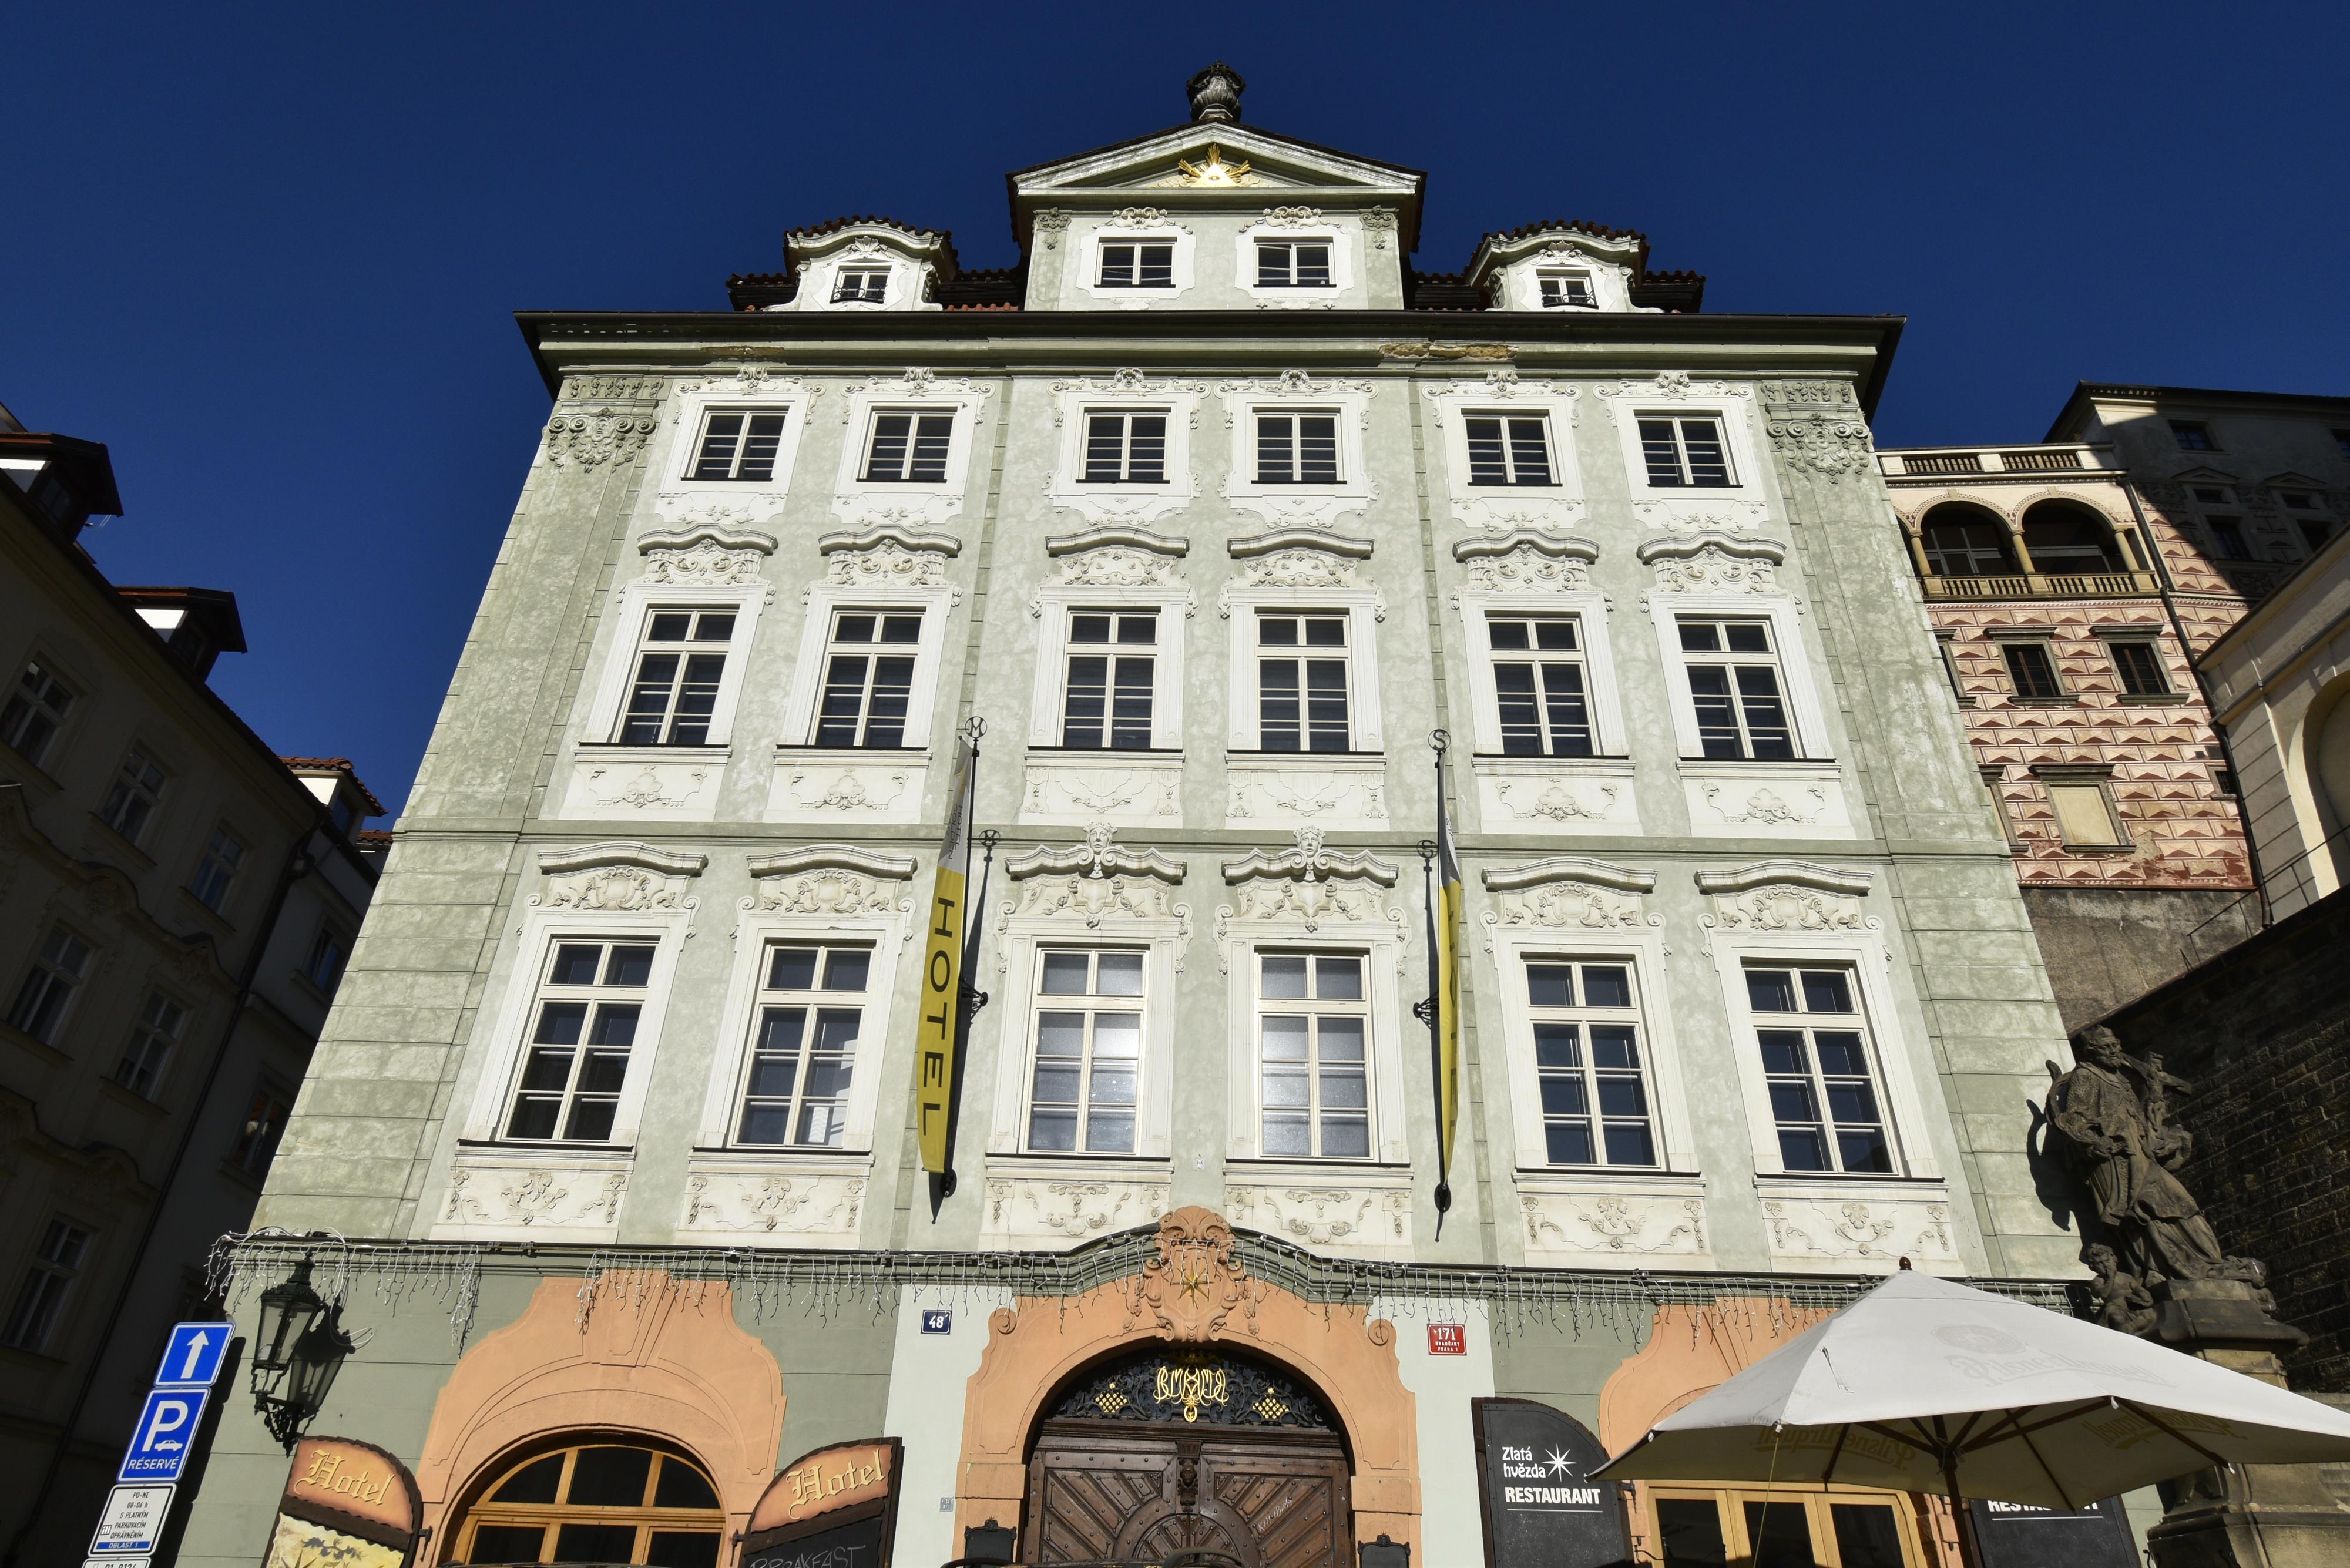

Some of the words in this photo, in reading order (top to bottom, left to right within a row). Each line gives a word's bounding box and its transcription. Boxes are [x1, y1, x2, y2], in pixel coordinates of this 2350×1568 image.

[954, 805, 964, 850] HOTEL
[923, 897, 955, 1136] HOTEL
[929, 1315, 944, 1328] 48
[1438, 1328, 1456, 1340] 171
[142, 1401, 189, 1452] P
[1502, 1446, 1533, 1461] Zlatá
[127, 1457, 179, 1470] RÉSERVÉ
[1503, 1462, 1546, 1478] hvězda
[294, 1449, 395, 1506] Hotel
[786, 1448, 885, 1520] Hotel
[1505, 1486, 1600, 1504] RESTAURANT
[125, 1510, 149, 1519] PLATNÝM
[115, 1519, 147, 1529] PARKOVACÍM
